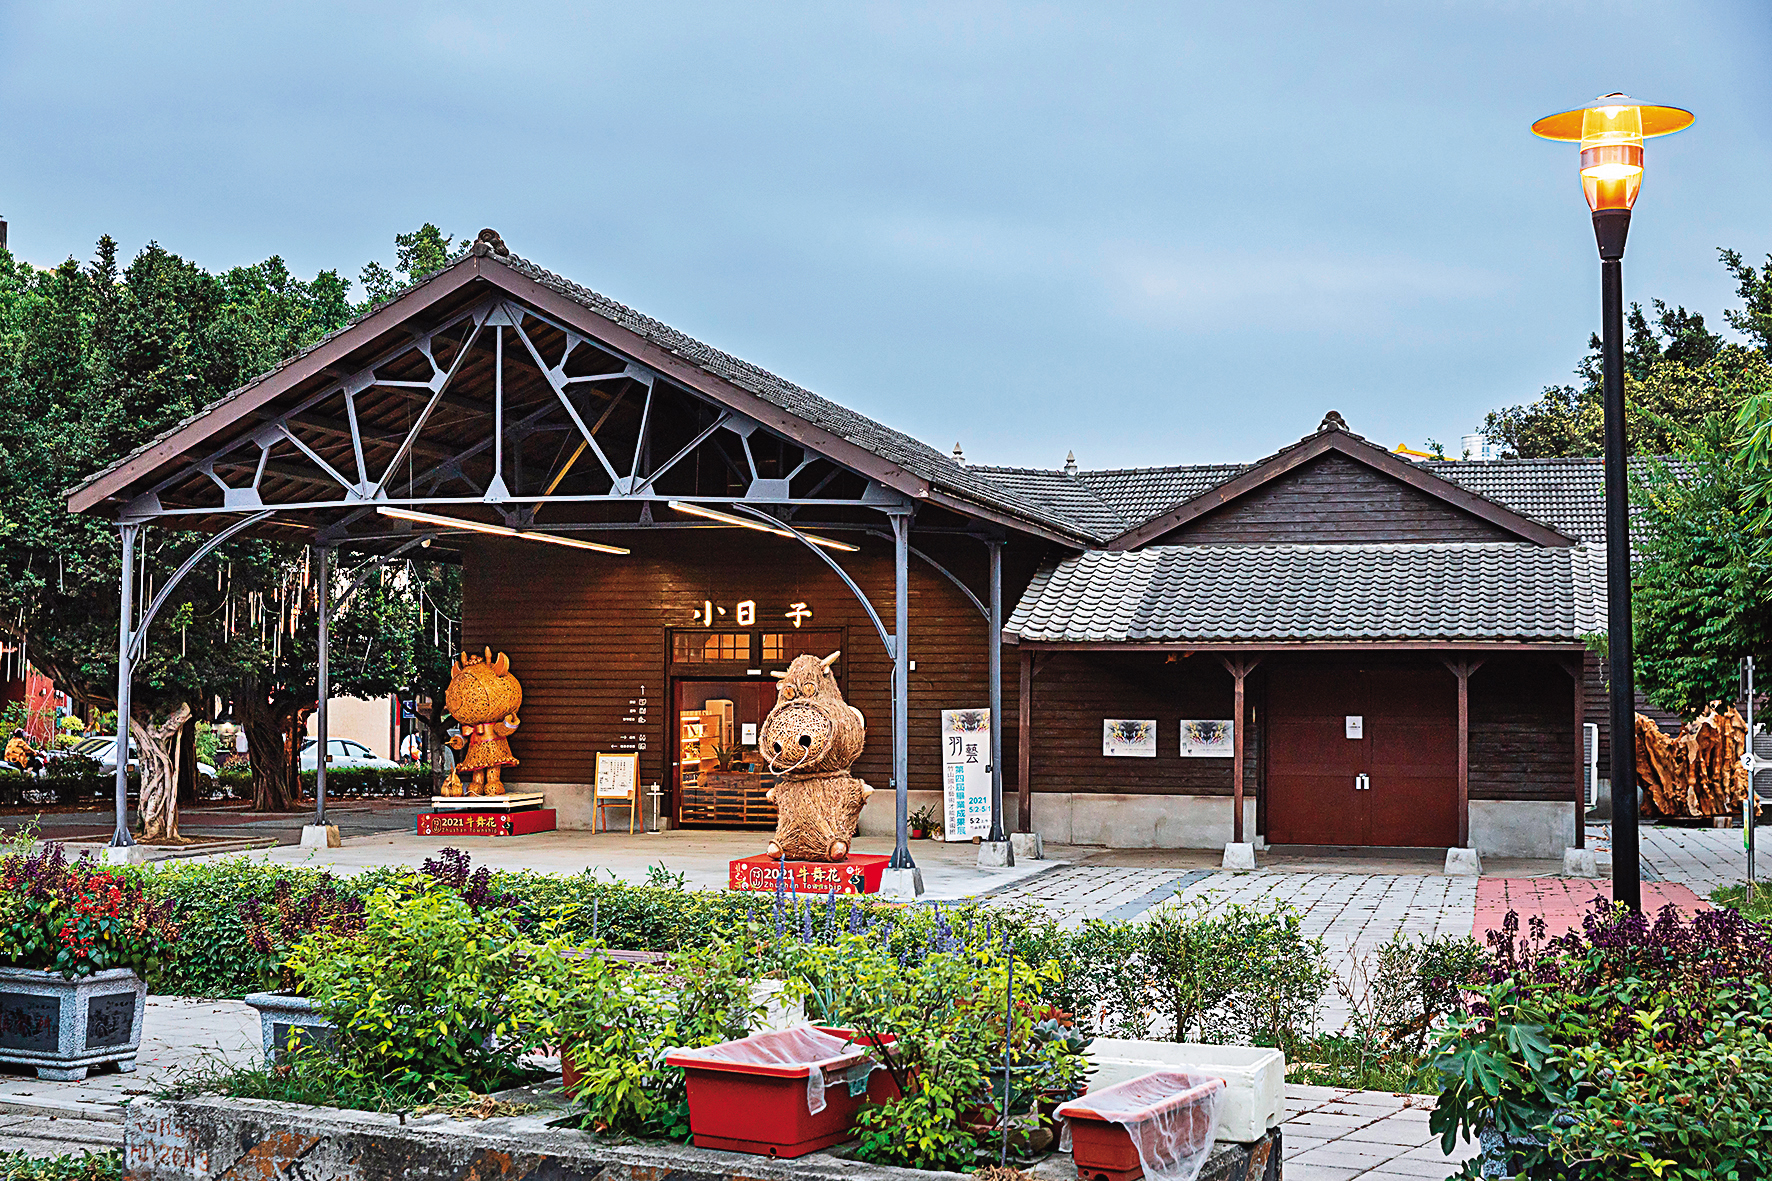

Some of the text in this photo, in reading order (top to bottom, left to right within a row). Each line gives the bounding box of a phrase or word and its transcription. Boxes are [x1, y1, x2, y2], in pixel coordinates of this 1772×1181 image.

[693, 599, 813, 628] 小日子
[1746, 757, 1751, 766] 2
[442, 818, 464, 827] 2021
[764, 868, 794, 880] 2021
[764, 881, 799, 889] Zhuhn
